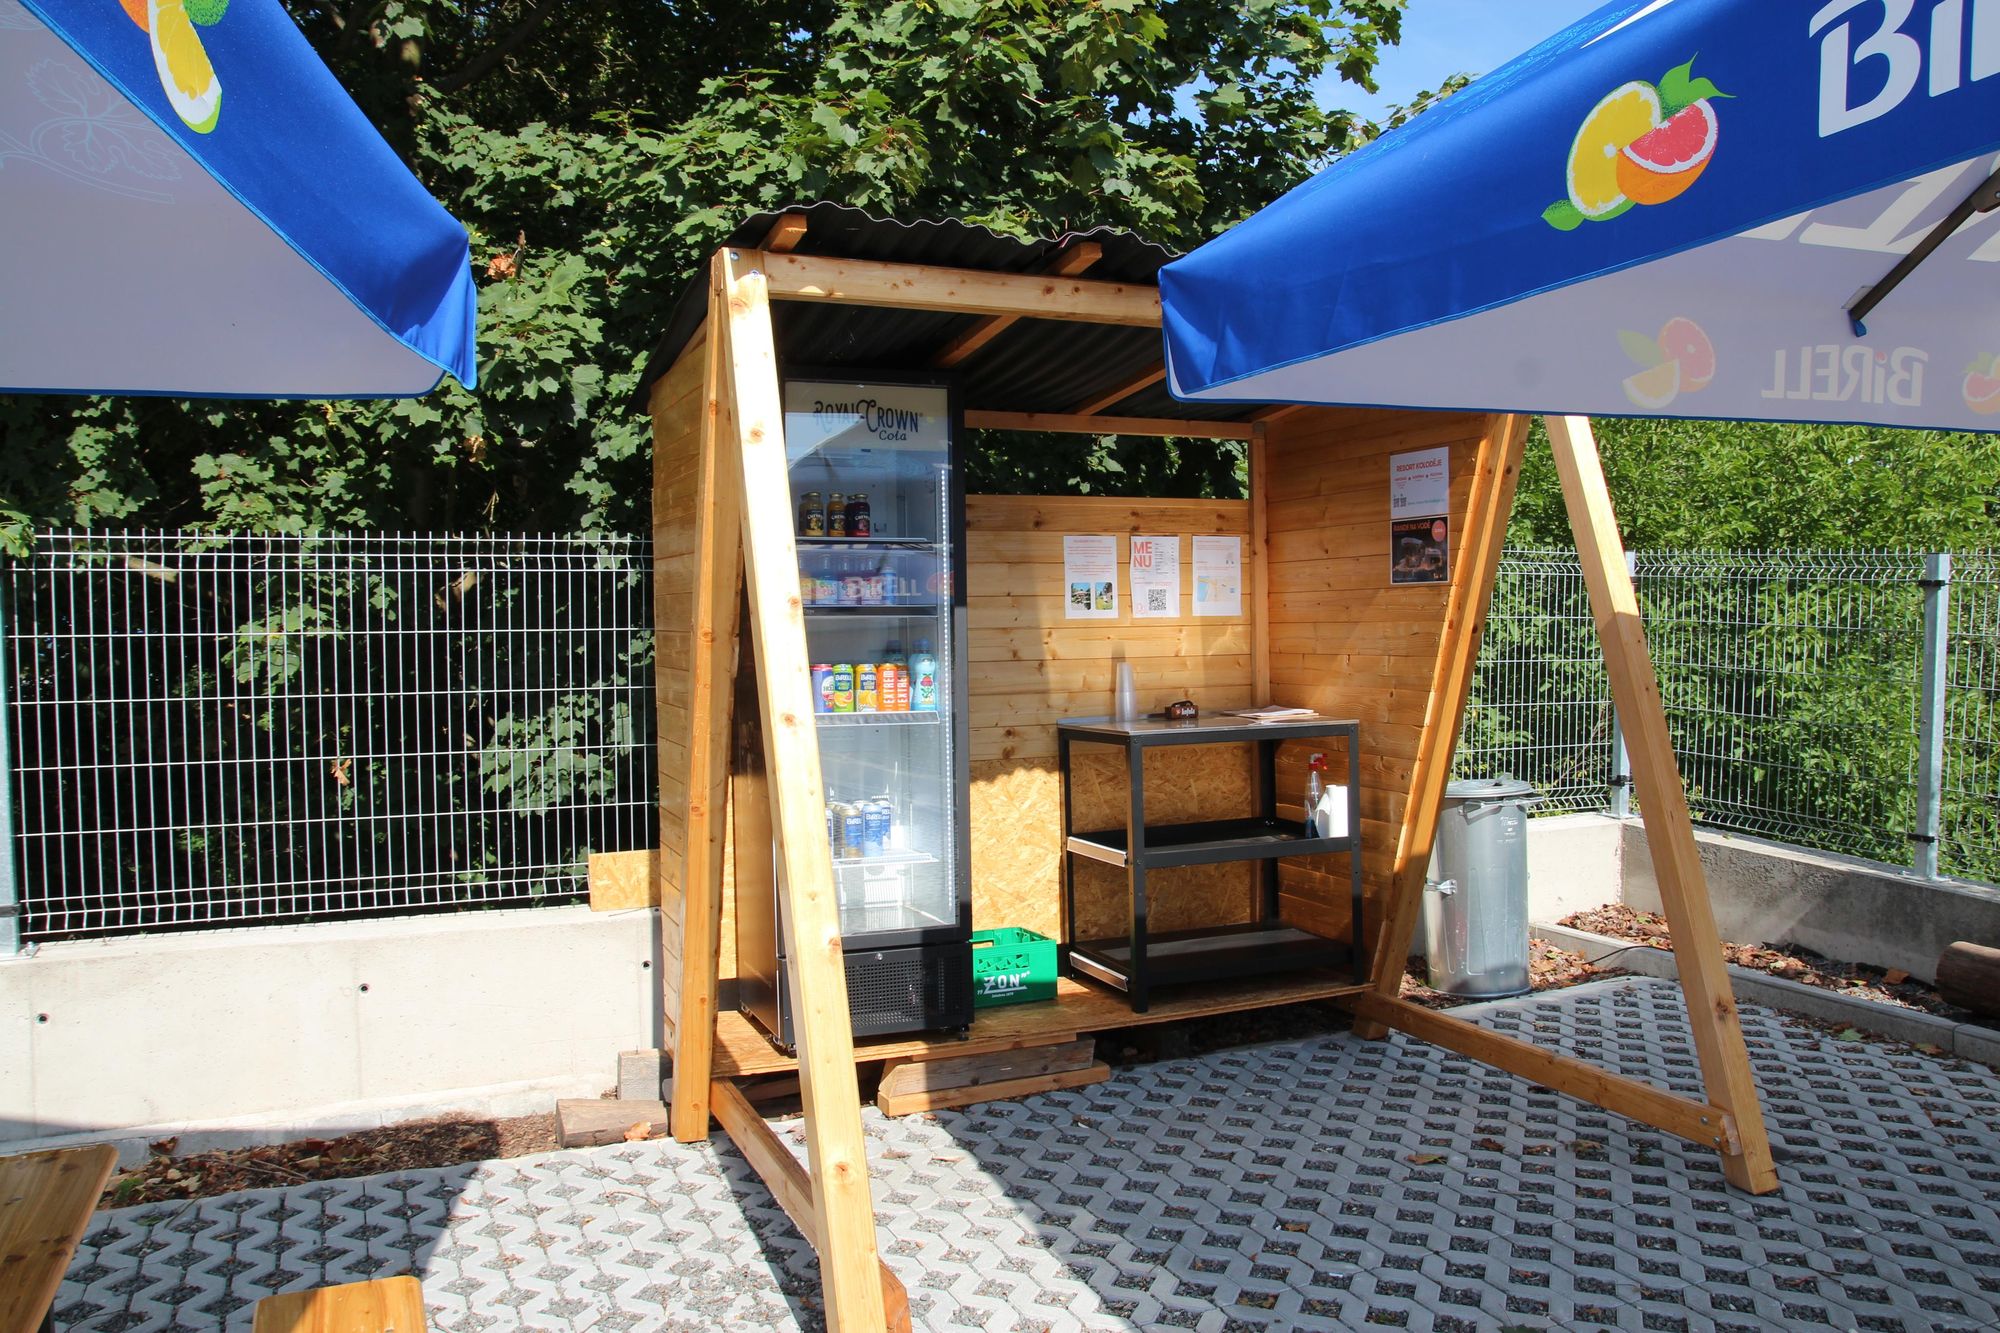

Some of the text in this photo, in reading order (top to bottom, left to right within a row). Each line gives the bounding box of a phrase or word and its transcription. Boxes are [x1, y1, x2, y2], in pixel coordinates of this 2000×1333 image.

[1809, 0, 2000, 138] Bi
[857, 399, 919, 432] CROWN
[879, 429, 907, 441] Cola
